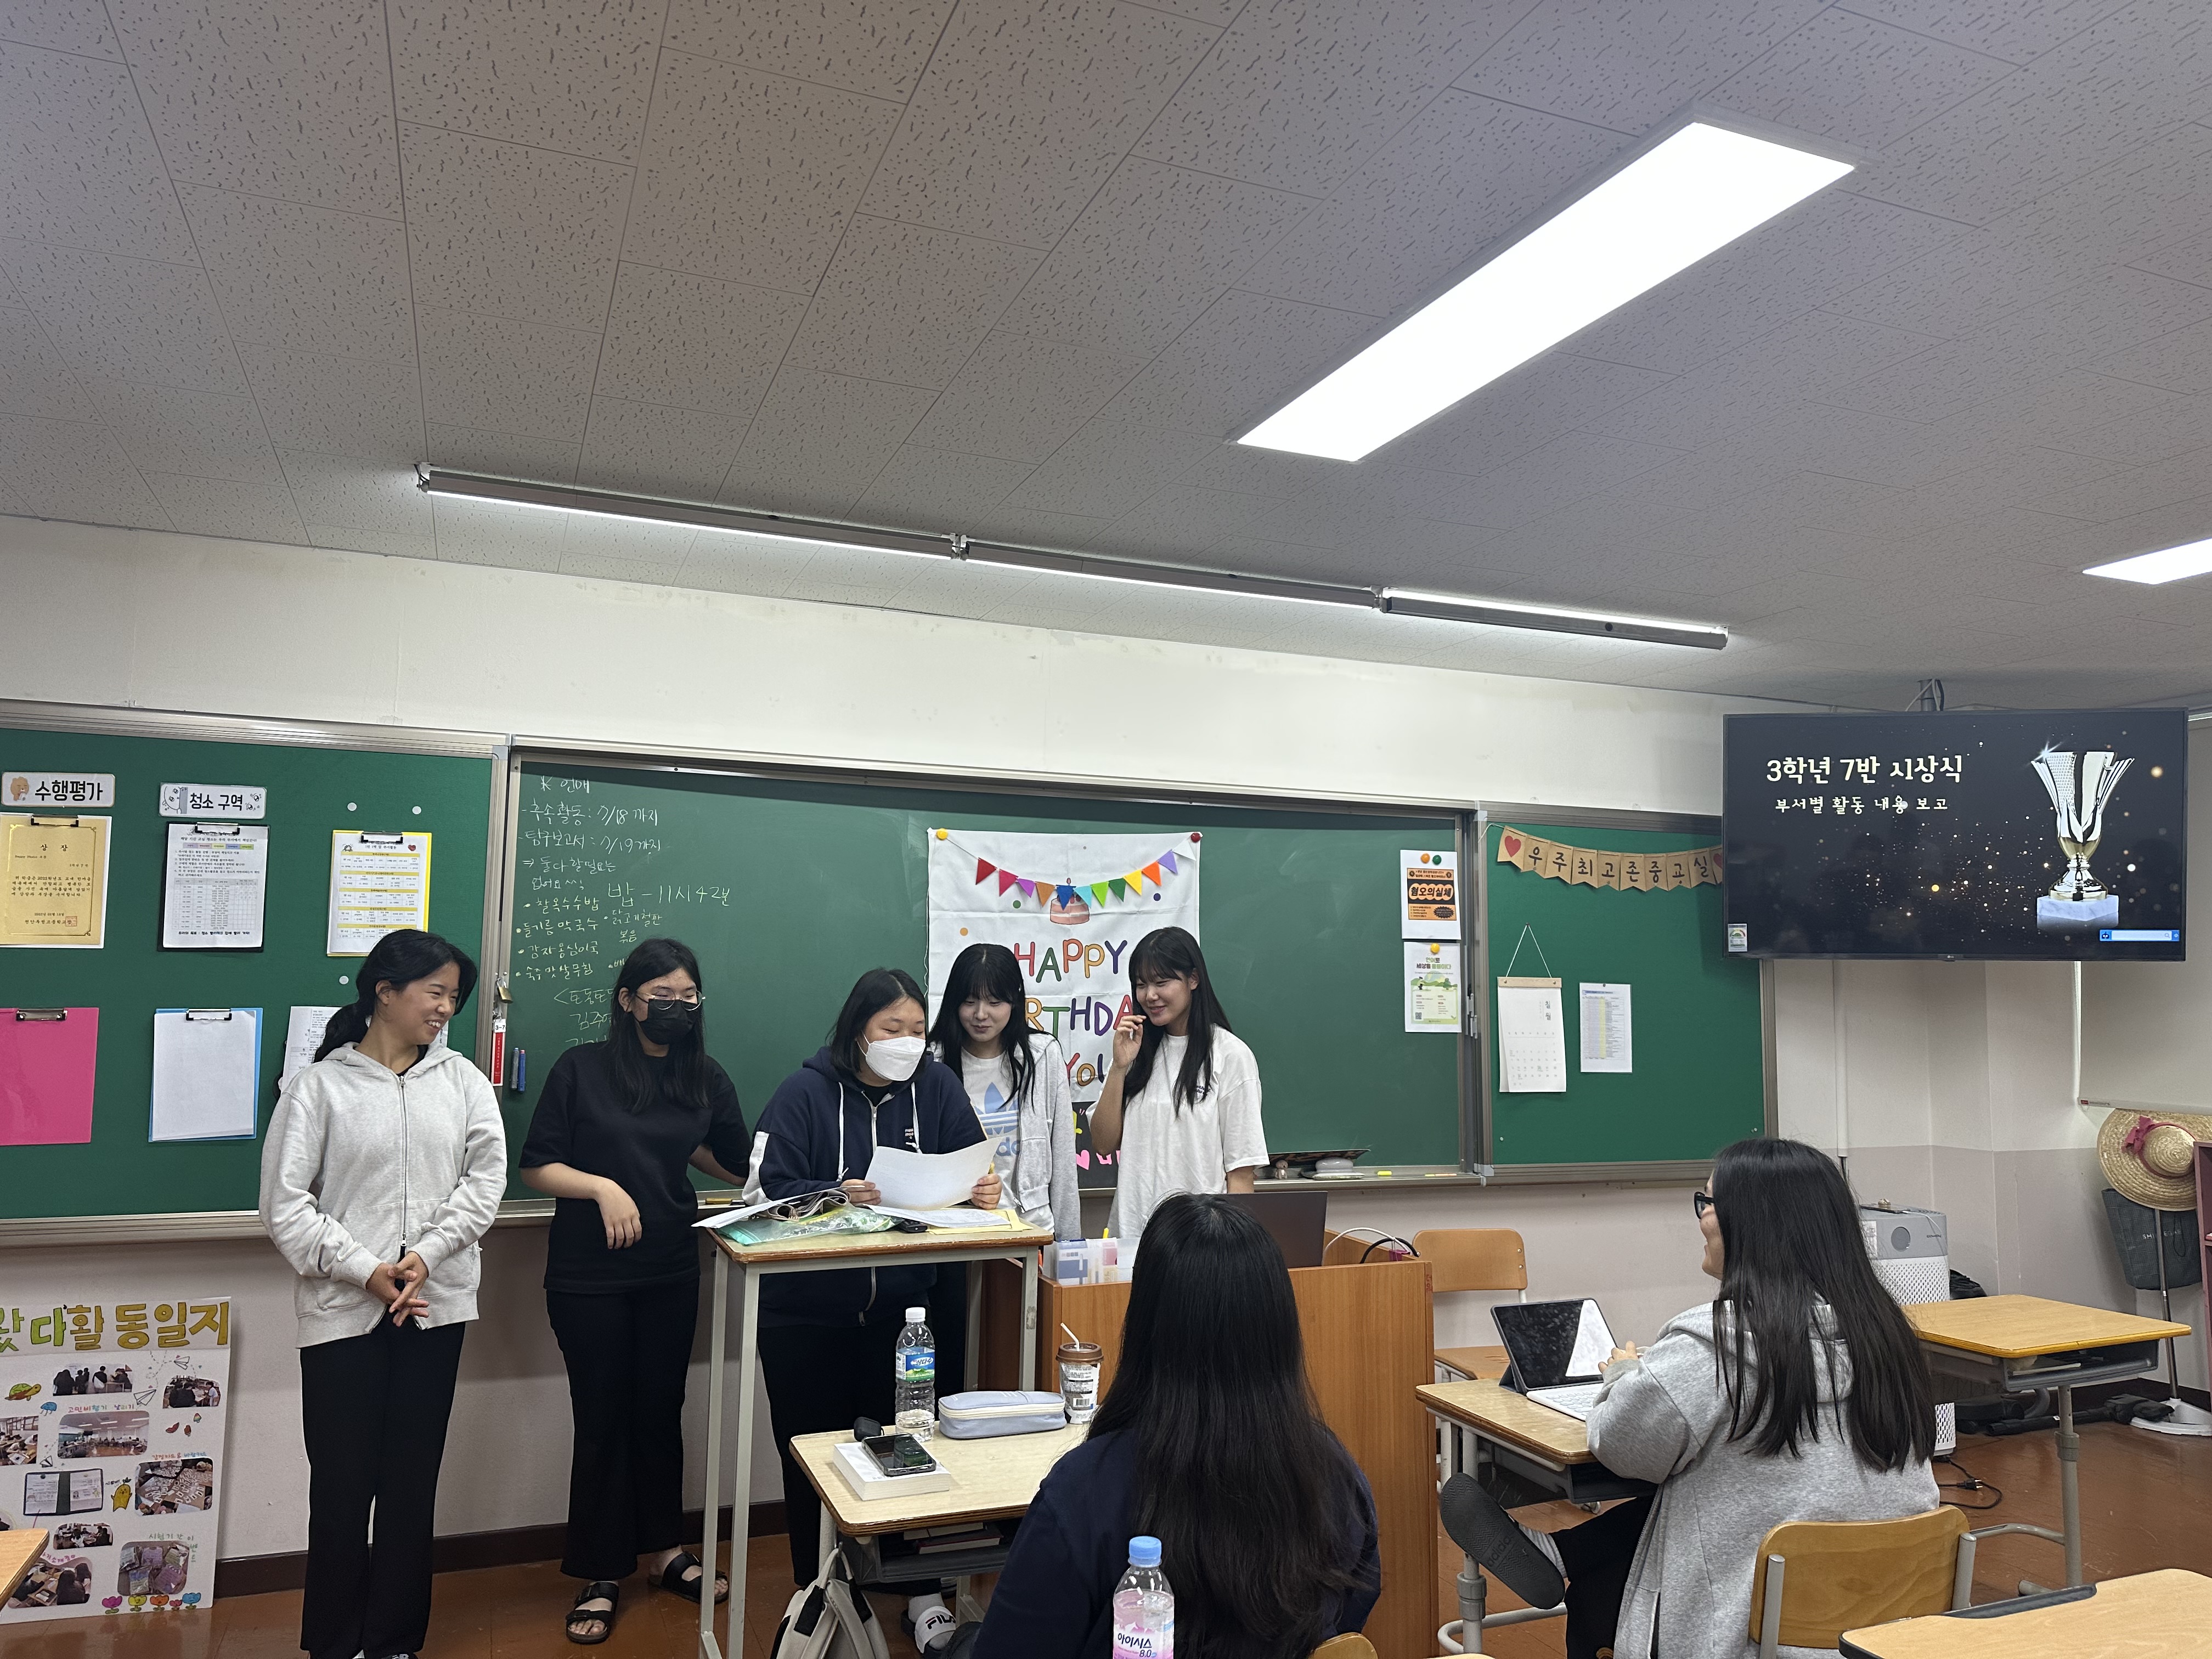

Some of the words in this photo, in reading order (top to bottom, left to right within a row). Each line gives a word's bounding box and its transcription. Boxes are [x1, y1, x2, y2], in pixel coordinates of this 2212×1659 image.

[1767, 755, 1831, 785] 3학년
[1839, 756, 1881, 784] 7반
[1890, 754, 1963, 785] 시상식
[35, 780, 103, 802] 수행평가
[190, 793, 214, 810] 청소
[218, 794, 243, 811] 구역
[1775, 797, 1824, 815] 부서별
[1832, 796, 1865, 815] 활동
[1874, 796, 1907, 815] 내용
[1916, 797, 1948, 811] 보고
[608, 882, 636, 908] 밥
[1014, 938, 1128, 983] HAPPY
[1025, 994, 1133, 1040] RTHDA
[66, 1301, 229, 1351] 활동일지
[1139, 1650, 1152, 1658] 8.0
